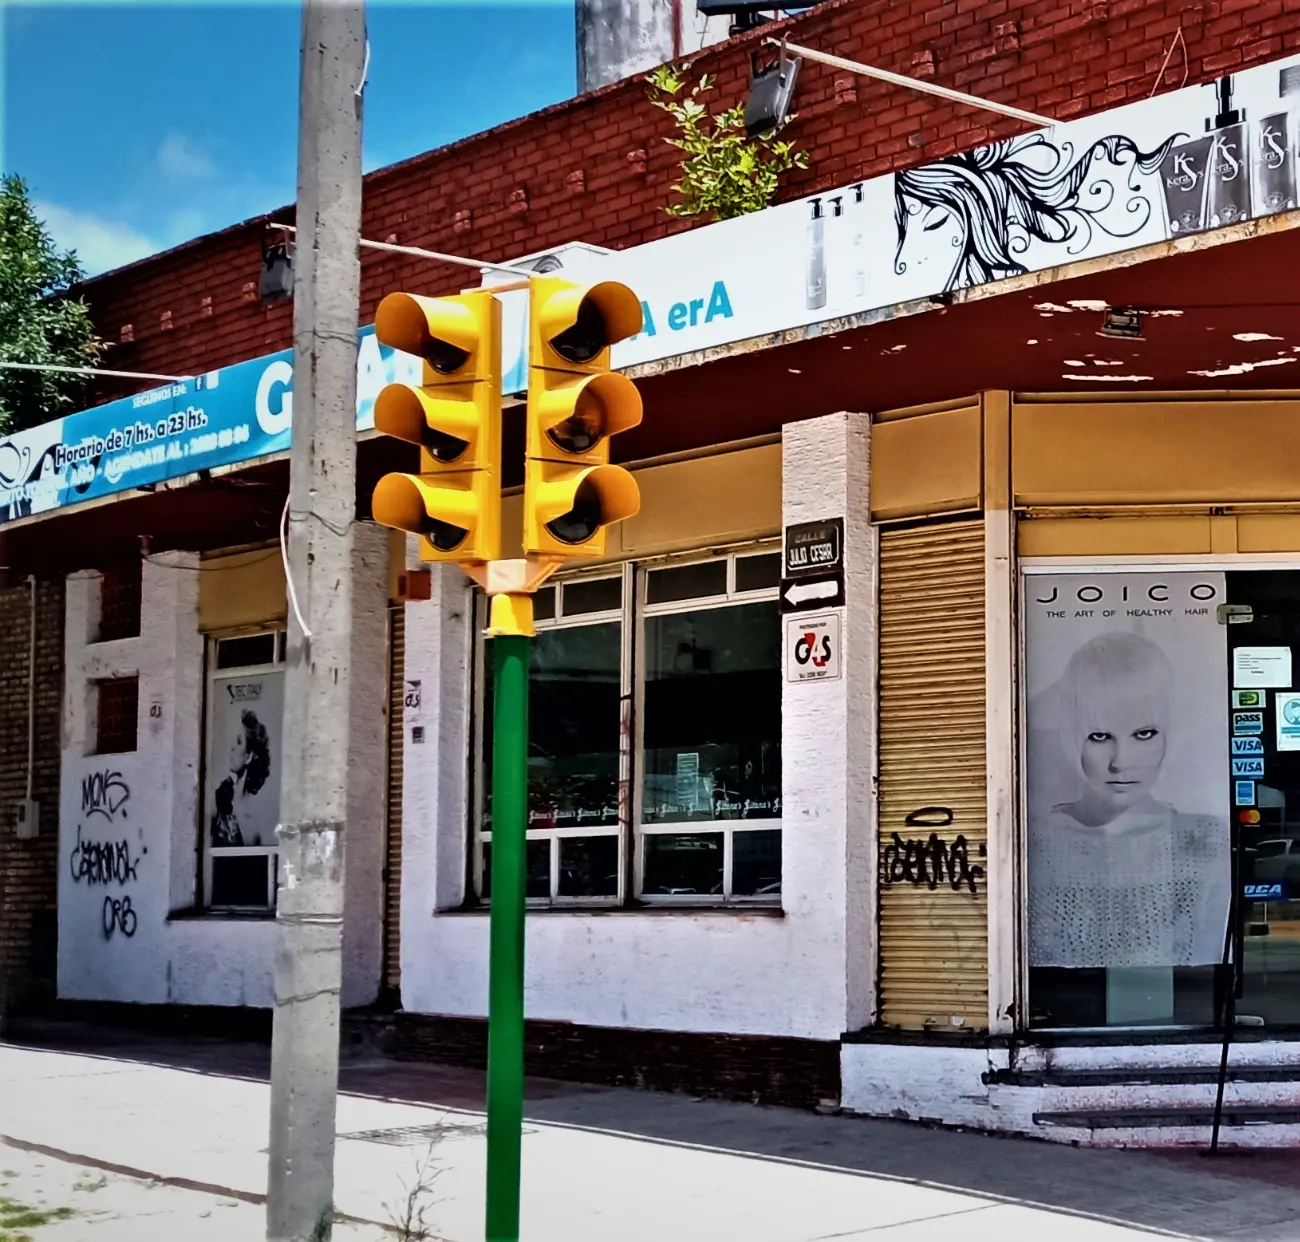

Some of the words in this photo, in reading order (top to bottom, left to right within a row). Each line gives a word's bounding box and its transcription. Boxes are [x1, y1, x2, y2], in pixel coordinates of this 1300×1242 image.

[668, 280, 734, 331] erA
[56, 439, 103, 467] Horario
[106, 431, 122, 451] de
[126, 429, 132, 446] 7
[136, 425, 153, 443] hs.
[157, 424, 165, 436] a
[169, 415, 184, 433] 23
[188, 410, 206, 428] hs.
[789, 546, 807, 565] JULIO
[810, 543, 833, 563] CESAR
[1036, 584, 1216, 603] JOICO
[1046, 610, 1066, 618] THE
[1074, 610, 1094, 618] ART
[1126, 608, 1173, 617] HEALTHY
[1234, 713, 1261, 725] pass
[1234, 740, 1262, 751] VISA
[1234, 761, 1263, 772] VISA
